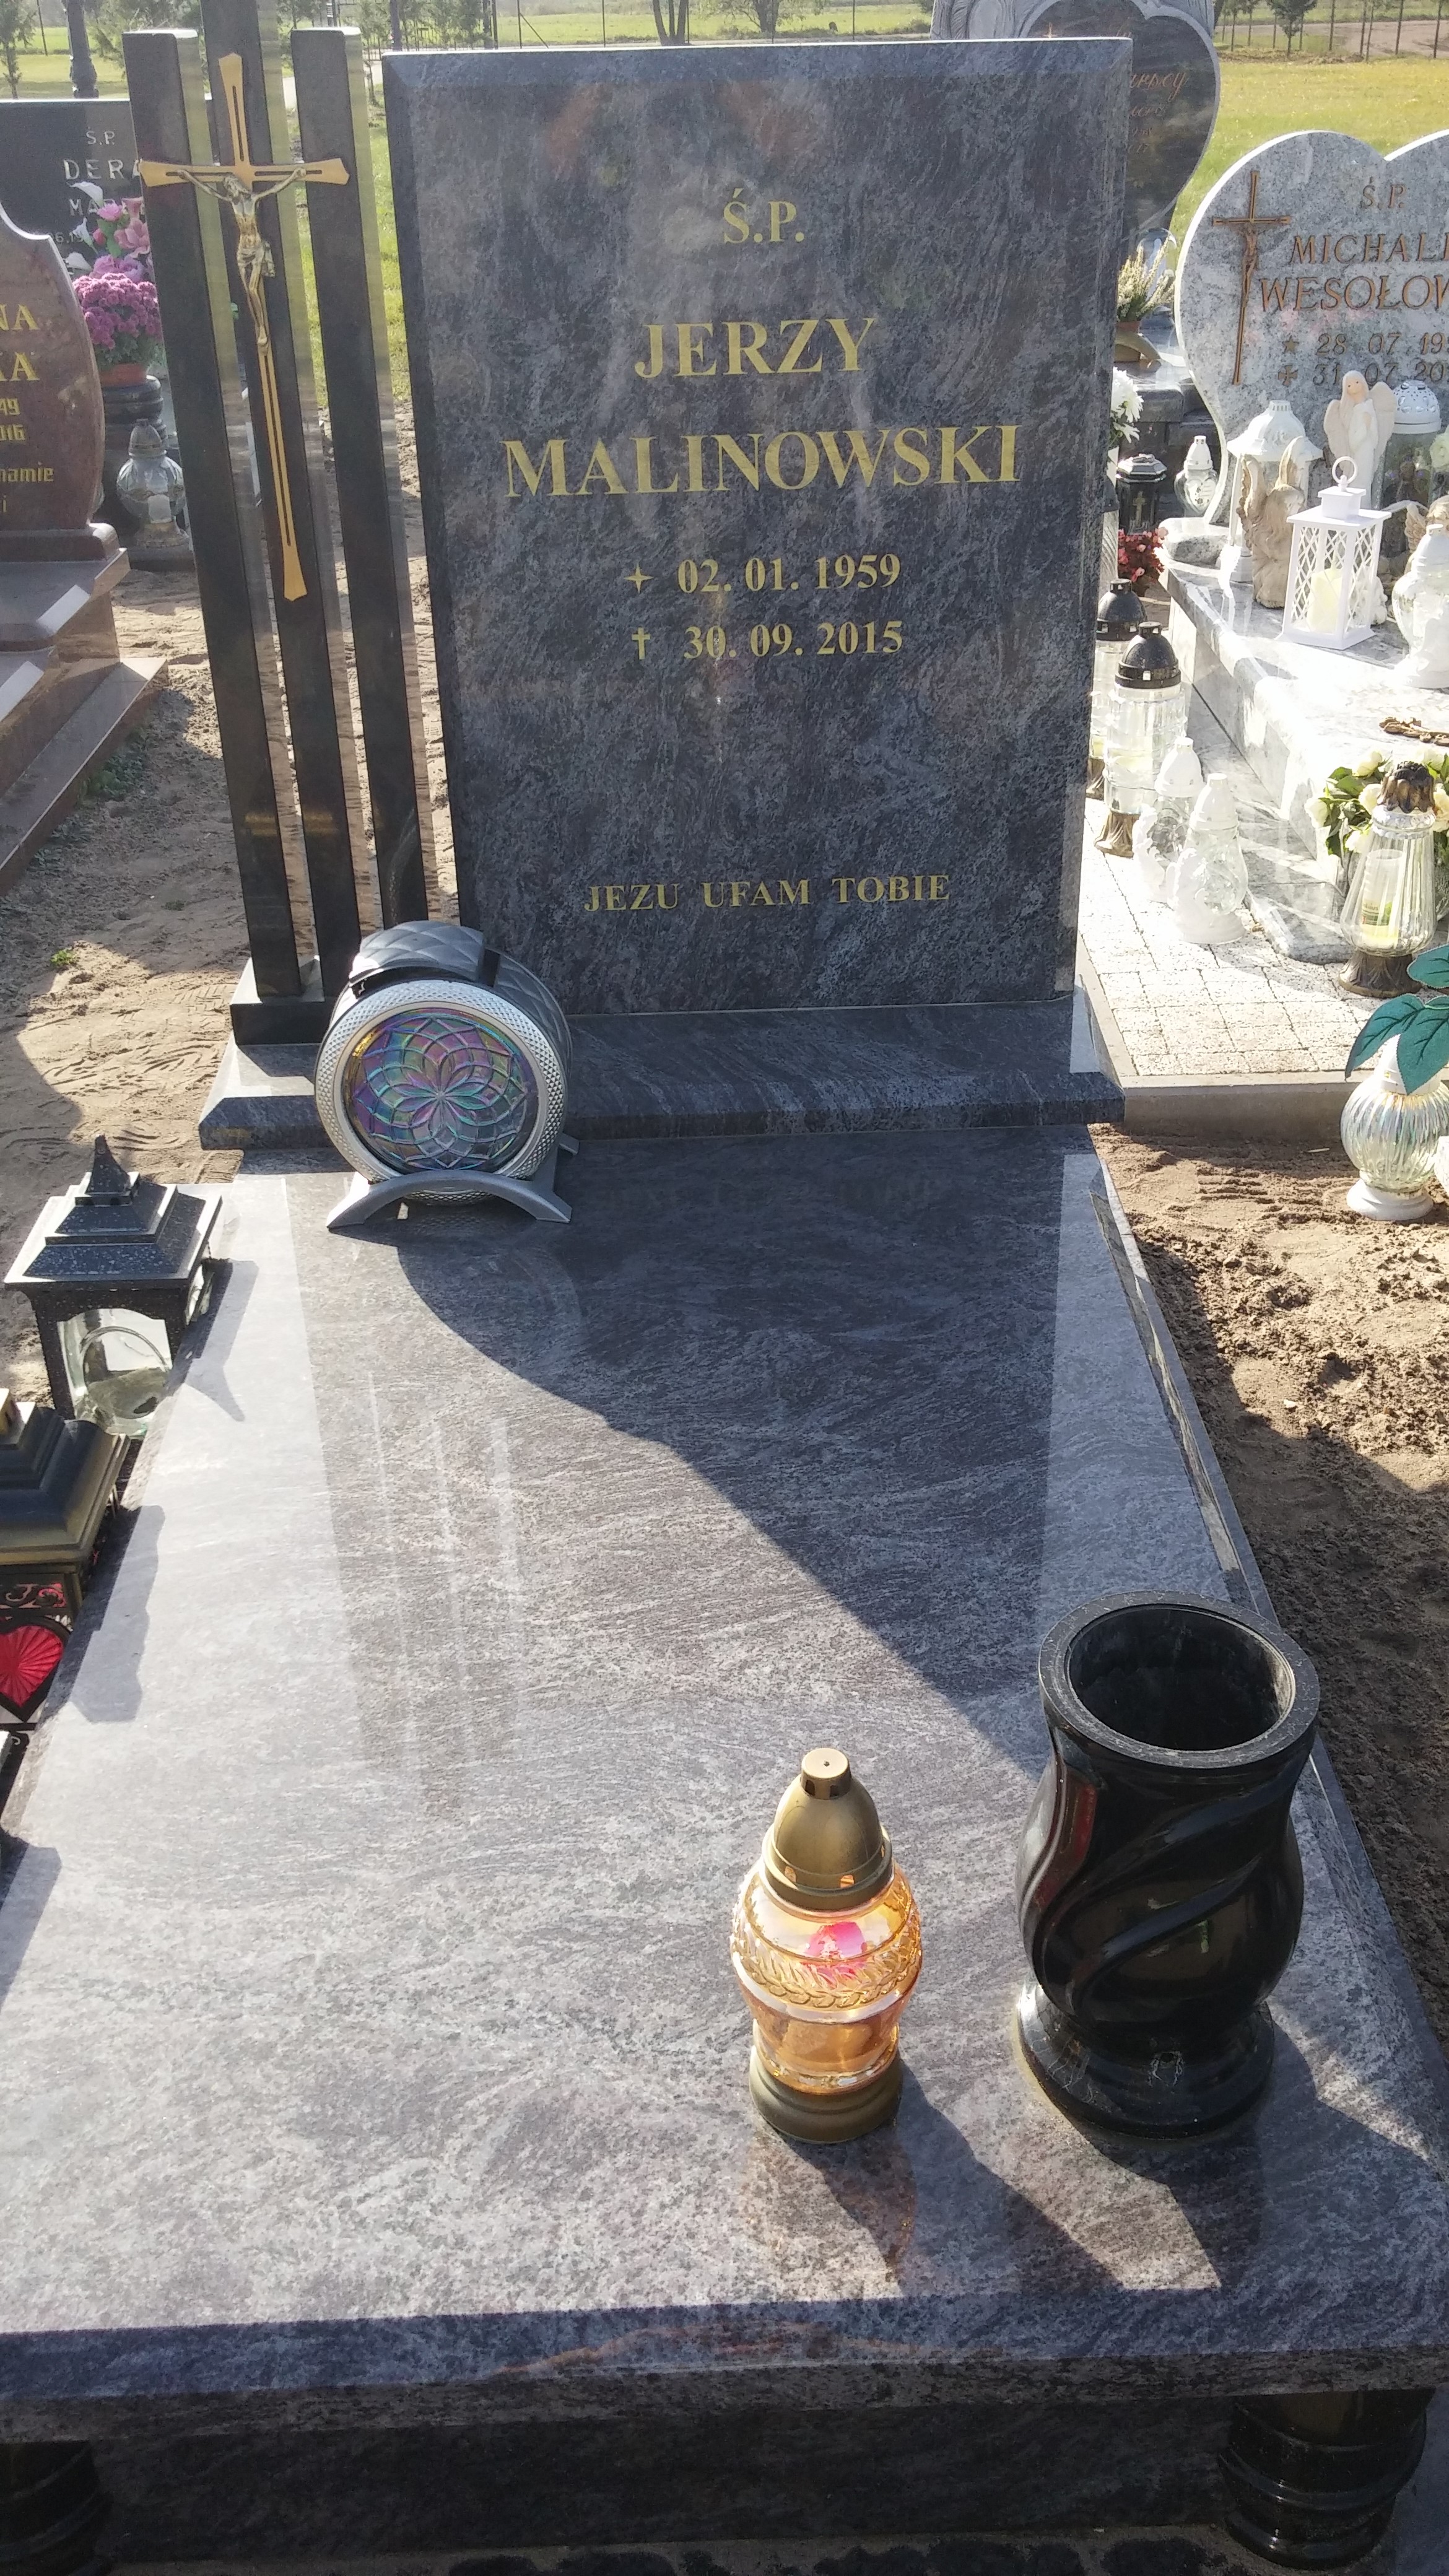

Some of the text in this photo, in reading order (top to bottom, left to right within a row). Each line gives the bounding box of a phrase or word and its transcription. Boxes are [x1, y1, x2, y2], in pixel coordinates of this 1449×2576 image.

[723, 188, 806, 243] Ś.P.
[635, 317, 877, 379] JERZY
[503, 425, 1024, 497] MALINOWSKI
[677, 554, 901, 593] 02. 01. 1959
[684, 620, 903, 659] 30. 09. 2015
[584, 874, 950, 912] JEZU UFAM TOBIE
